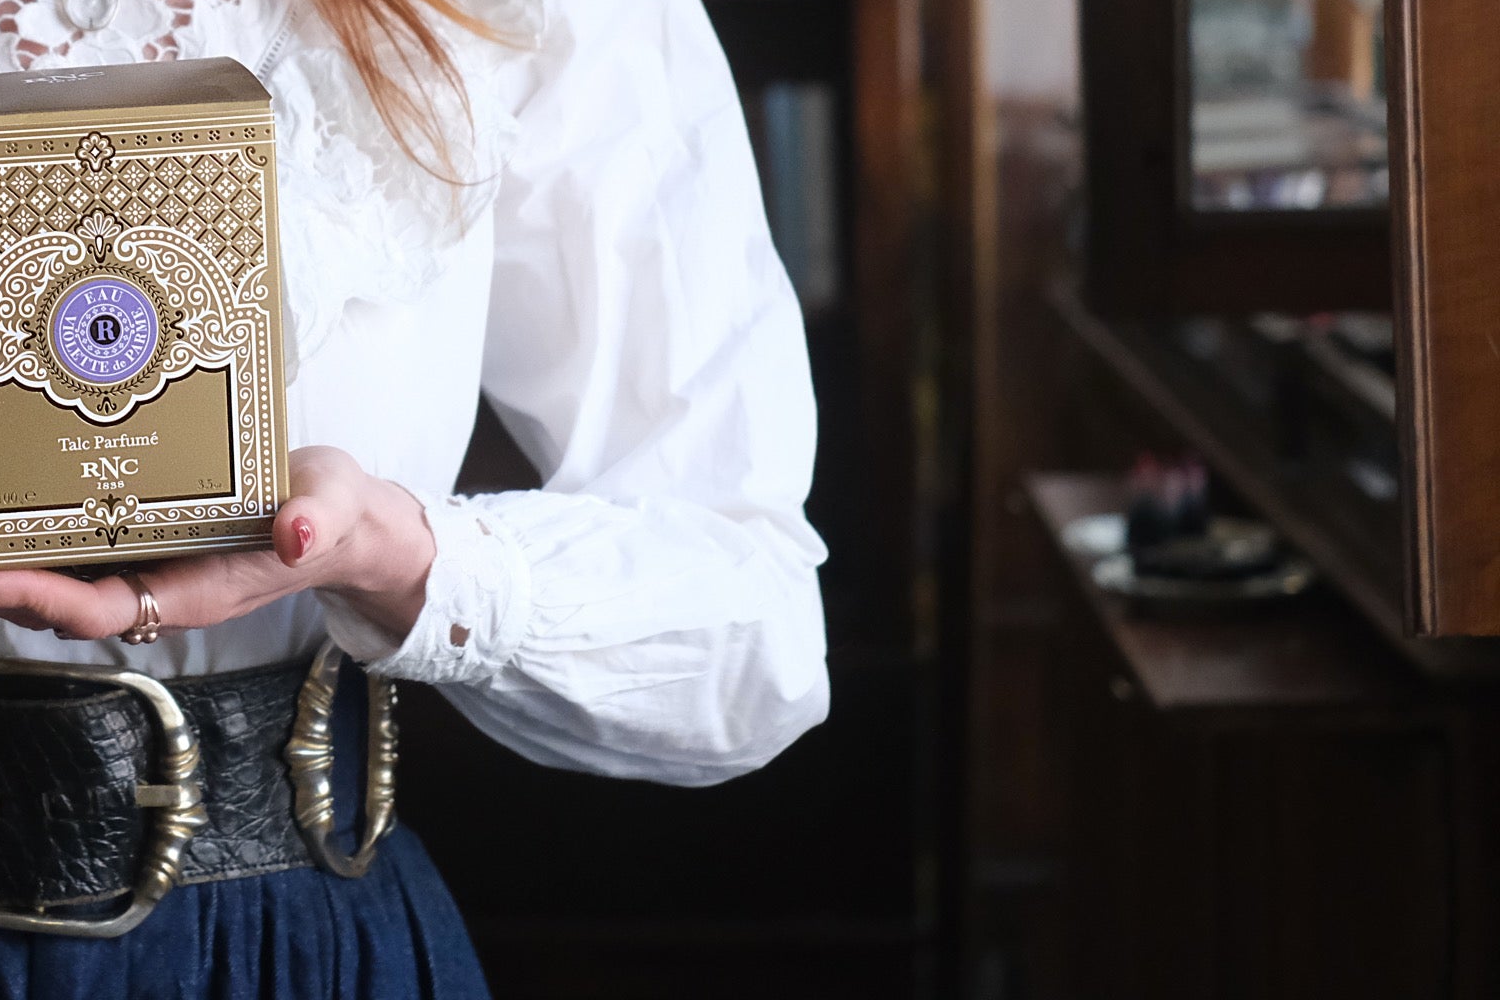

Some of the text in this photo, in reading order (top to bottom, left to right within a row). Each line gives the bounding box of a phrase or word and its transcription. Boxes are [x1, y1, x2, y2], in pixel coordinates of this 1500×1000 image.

[83, 288, 124, 305] EAU
[62, 307, 148, 373] VIOLETTE de PARME
[96, 319, 116, 341] R
[57, 431, 159, 452] Talc Parfumé
[80, 456, 139, 480] RNC
